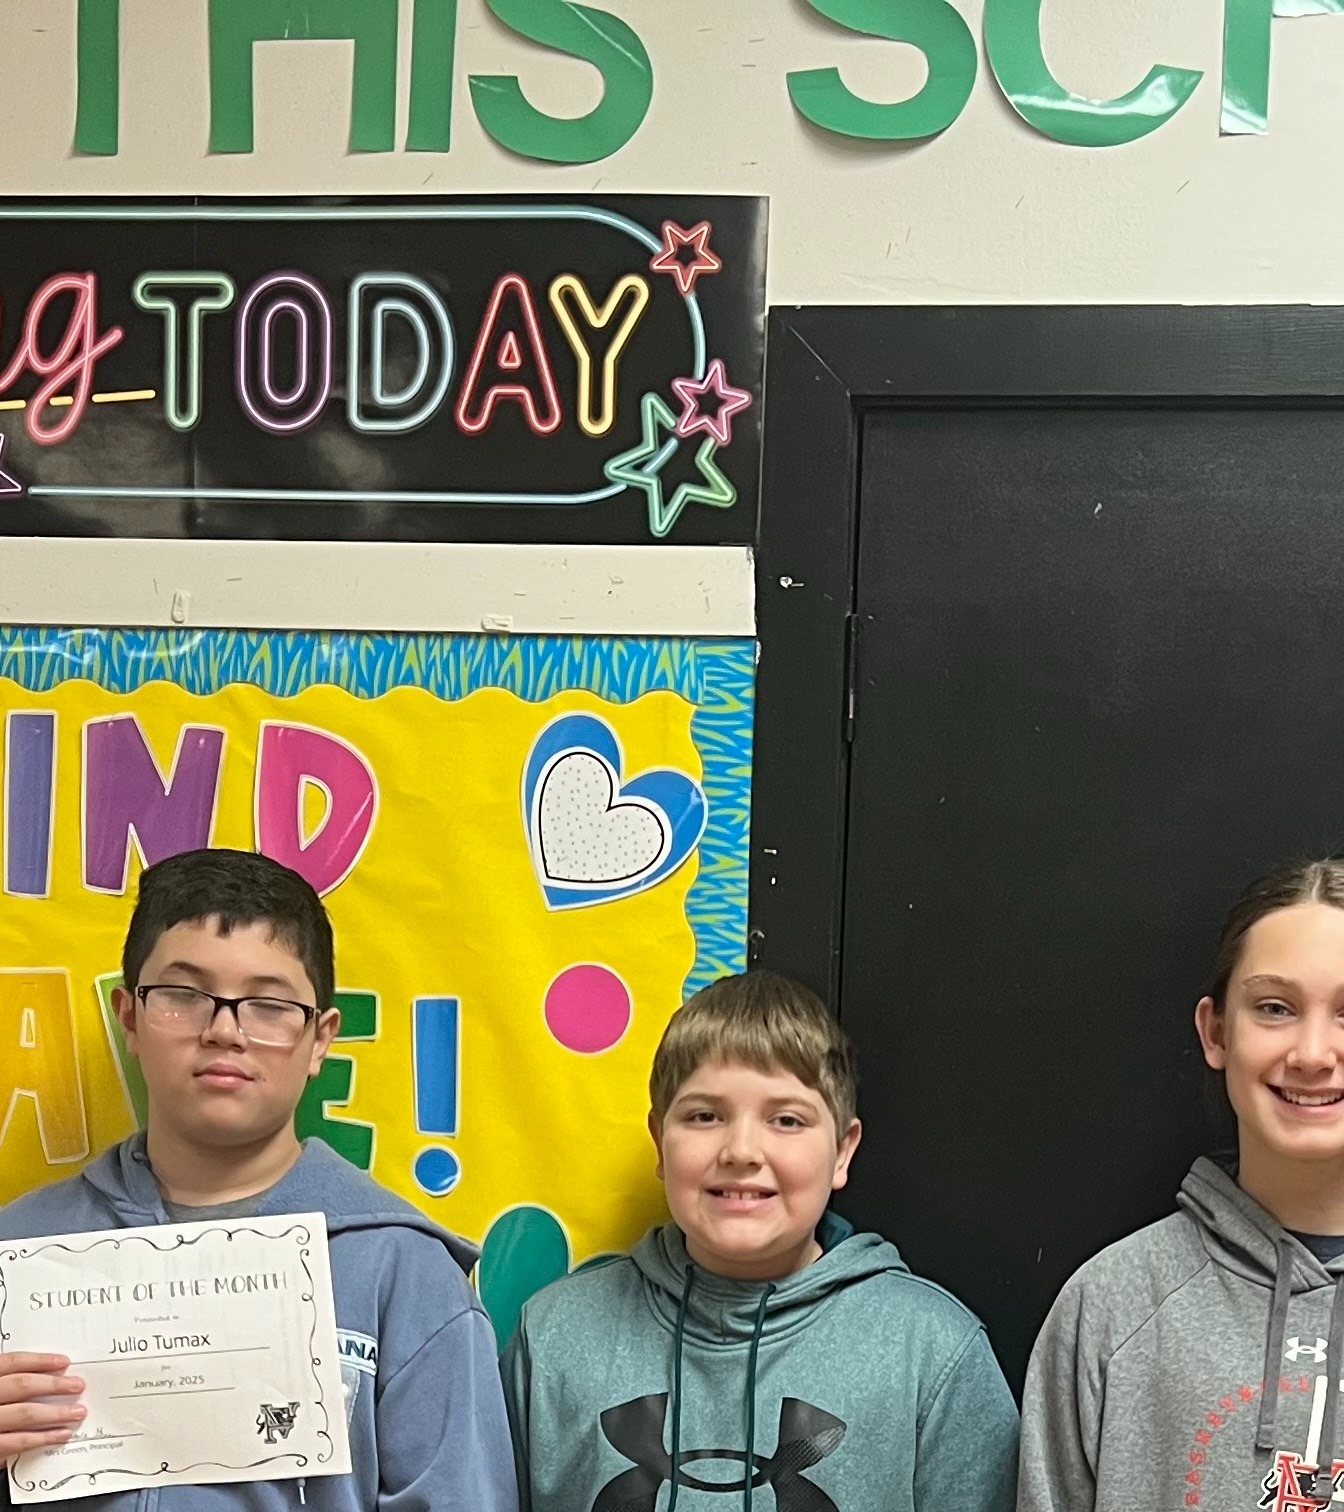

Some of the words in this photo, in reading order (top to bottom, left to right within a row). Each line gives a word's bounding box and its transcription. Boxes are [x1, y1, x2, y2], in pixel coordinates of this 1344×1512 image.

[131, 270, 652, 435] TODAY
[29, 1285, 124, 1311] STUDENT
[132, 1282, 159, 1302] OF
[168, 1279, 207, 1298] THE
[214, 1272, 288, 1295] MONTH
[109, 1337, 148, 1354] Julio
[152, 1333, 211, 1350] Tumax
[179, 1375, 206, 1386] 2025
